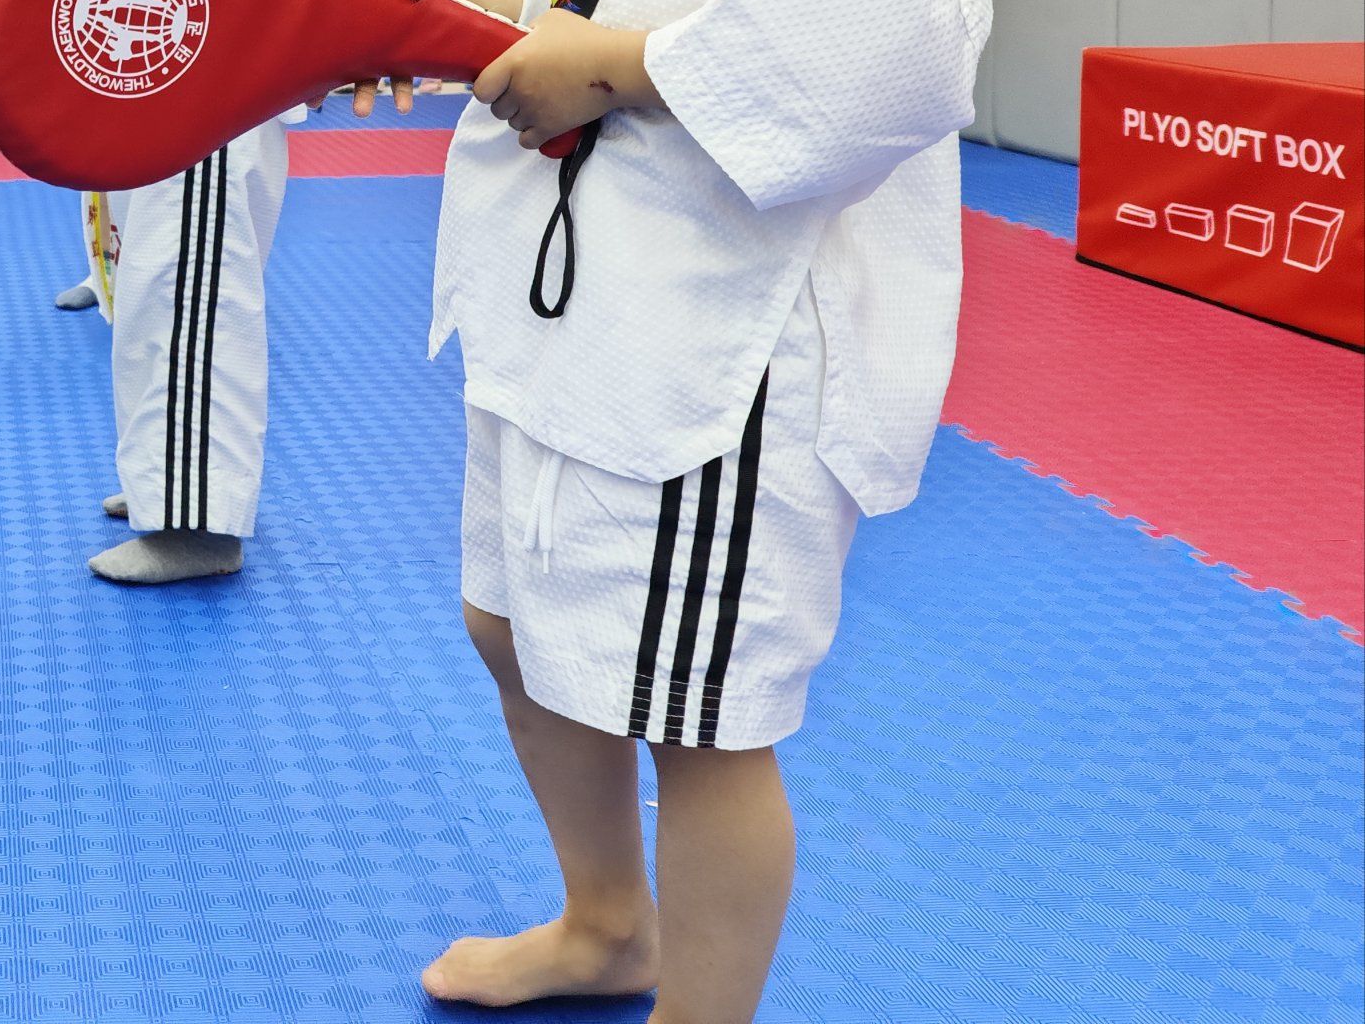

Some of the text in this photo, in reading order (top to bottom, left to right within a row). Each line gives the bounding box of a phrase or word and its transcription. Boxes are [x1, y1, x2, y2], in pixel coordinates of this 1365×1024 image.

[1123, 107, 1346, 180] PLYO SOFT BOX
